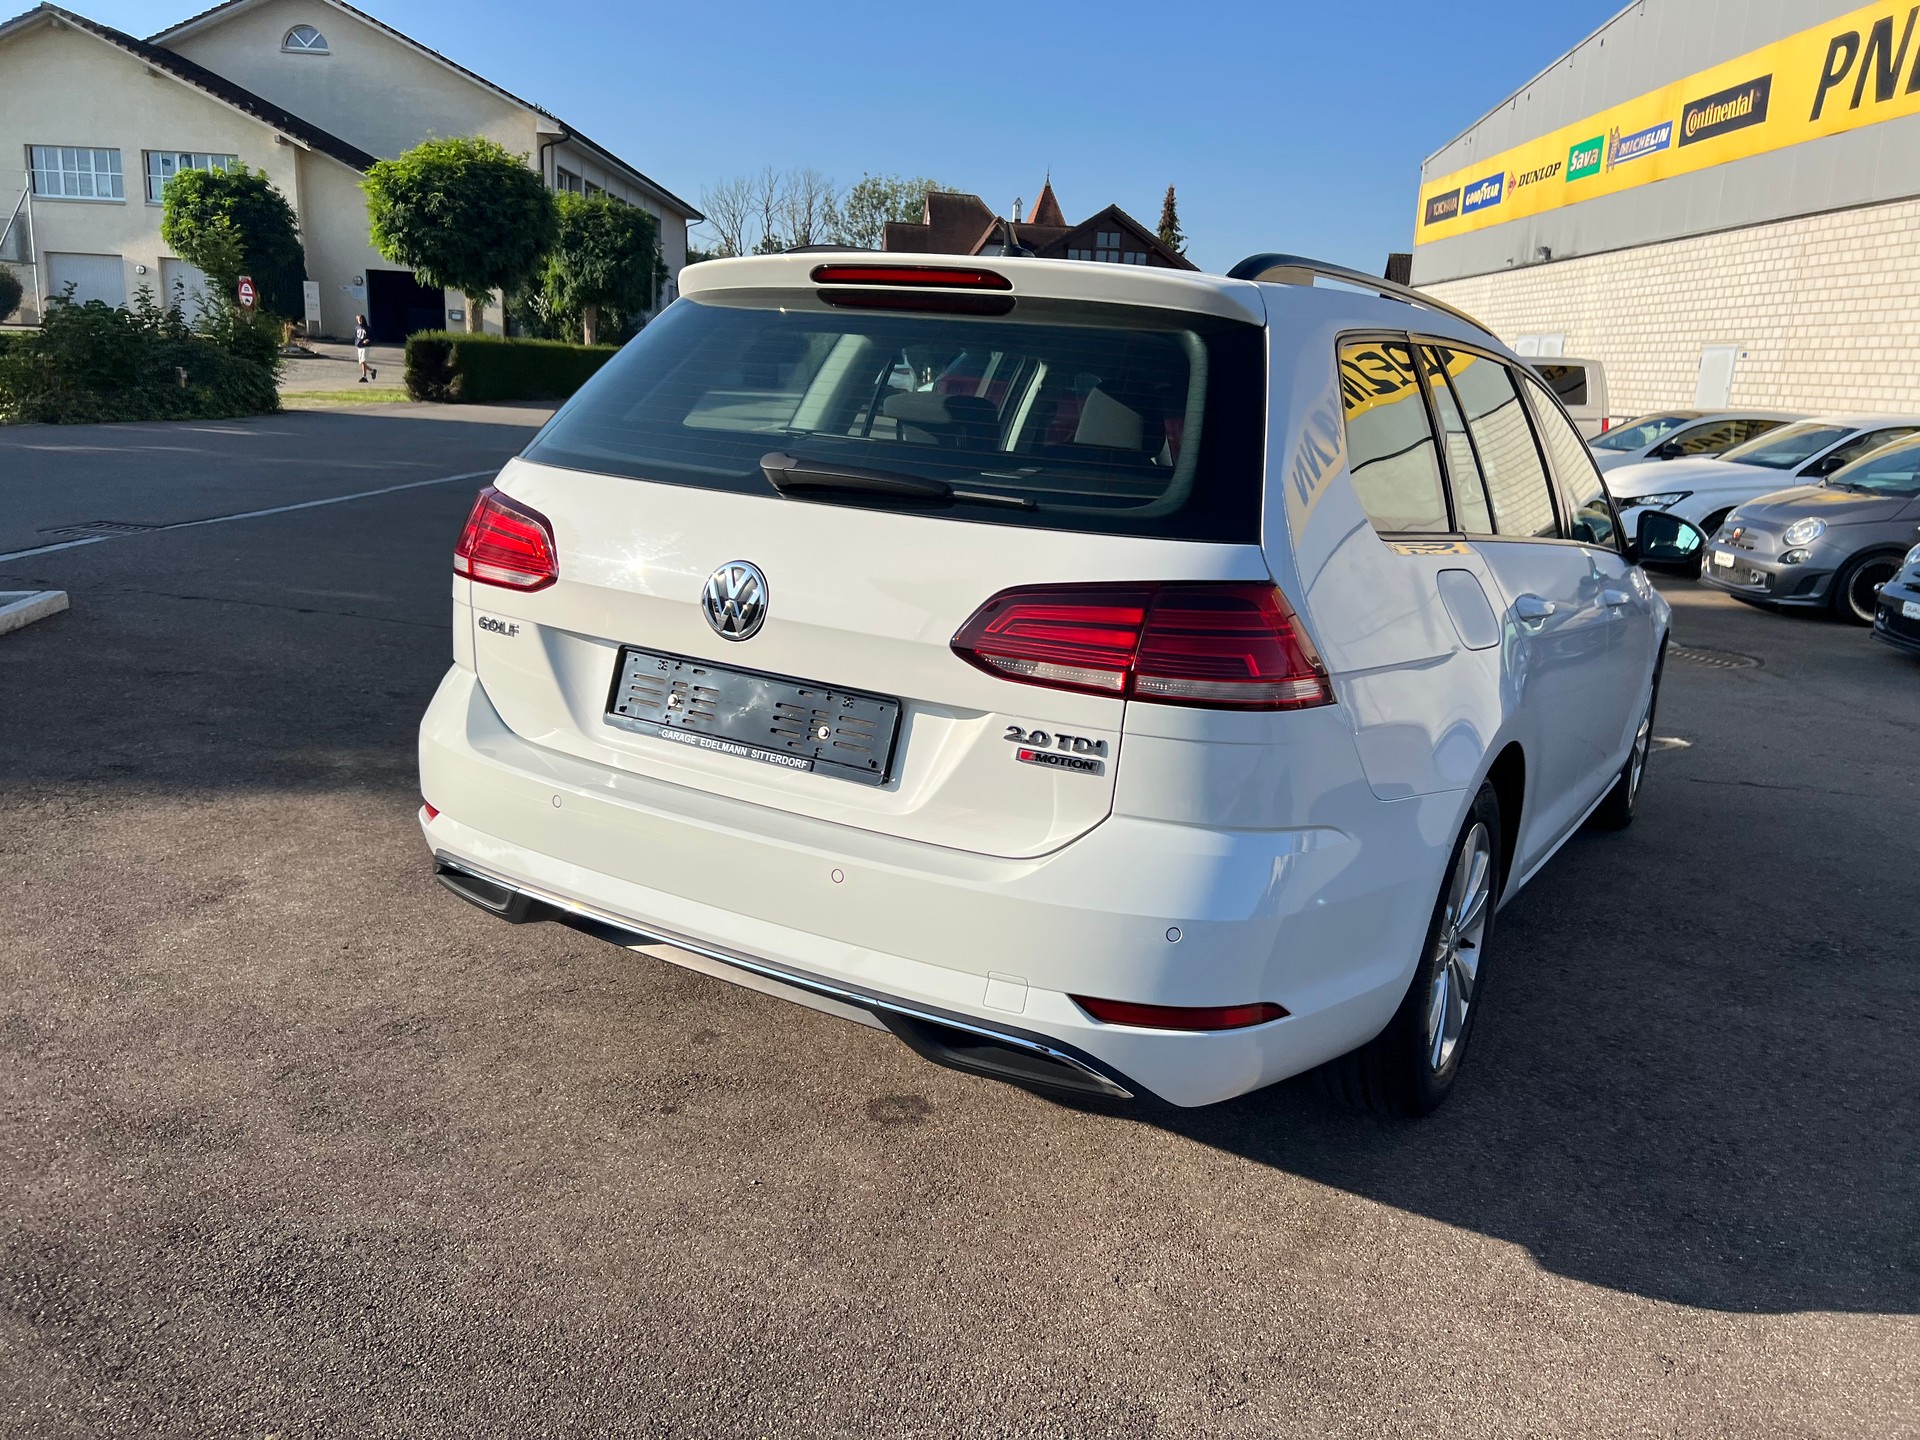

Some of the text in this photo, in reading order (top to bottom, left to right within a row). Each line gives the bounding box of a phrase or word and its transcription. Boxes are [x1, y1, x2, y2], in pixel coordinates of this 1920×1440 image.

[1808, 5, 1920, 122] PN
[1686, 89, 1754, 137] Continental
[1618, 127, 1670, 156] MICHELIN
[1569, 147, 1599, 172] Sava
[1517, 161, 1562, 188] DUNLOP
[1465, 182, 1500, 206] GOODYEAR
[478, 616, 520, 637] GOLF
[661, 729, 808, 769] GARAGE EDELMANN SITTERDORF
[1003, 726, 1109, 758] 2.0 TDI
